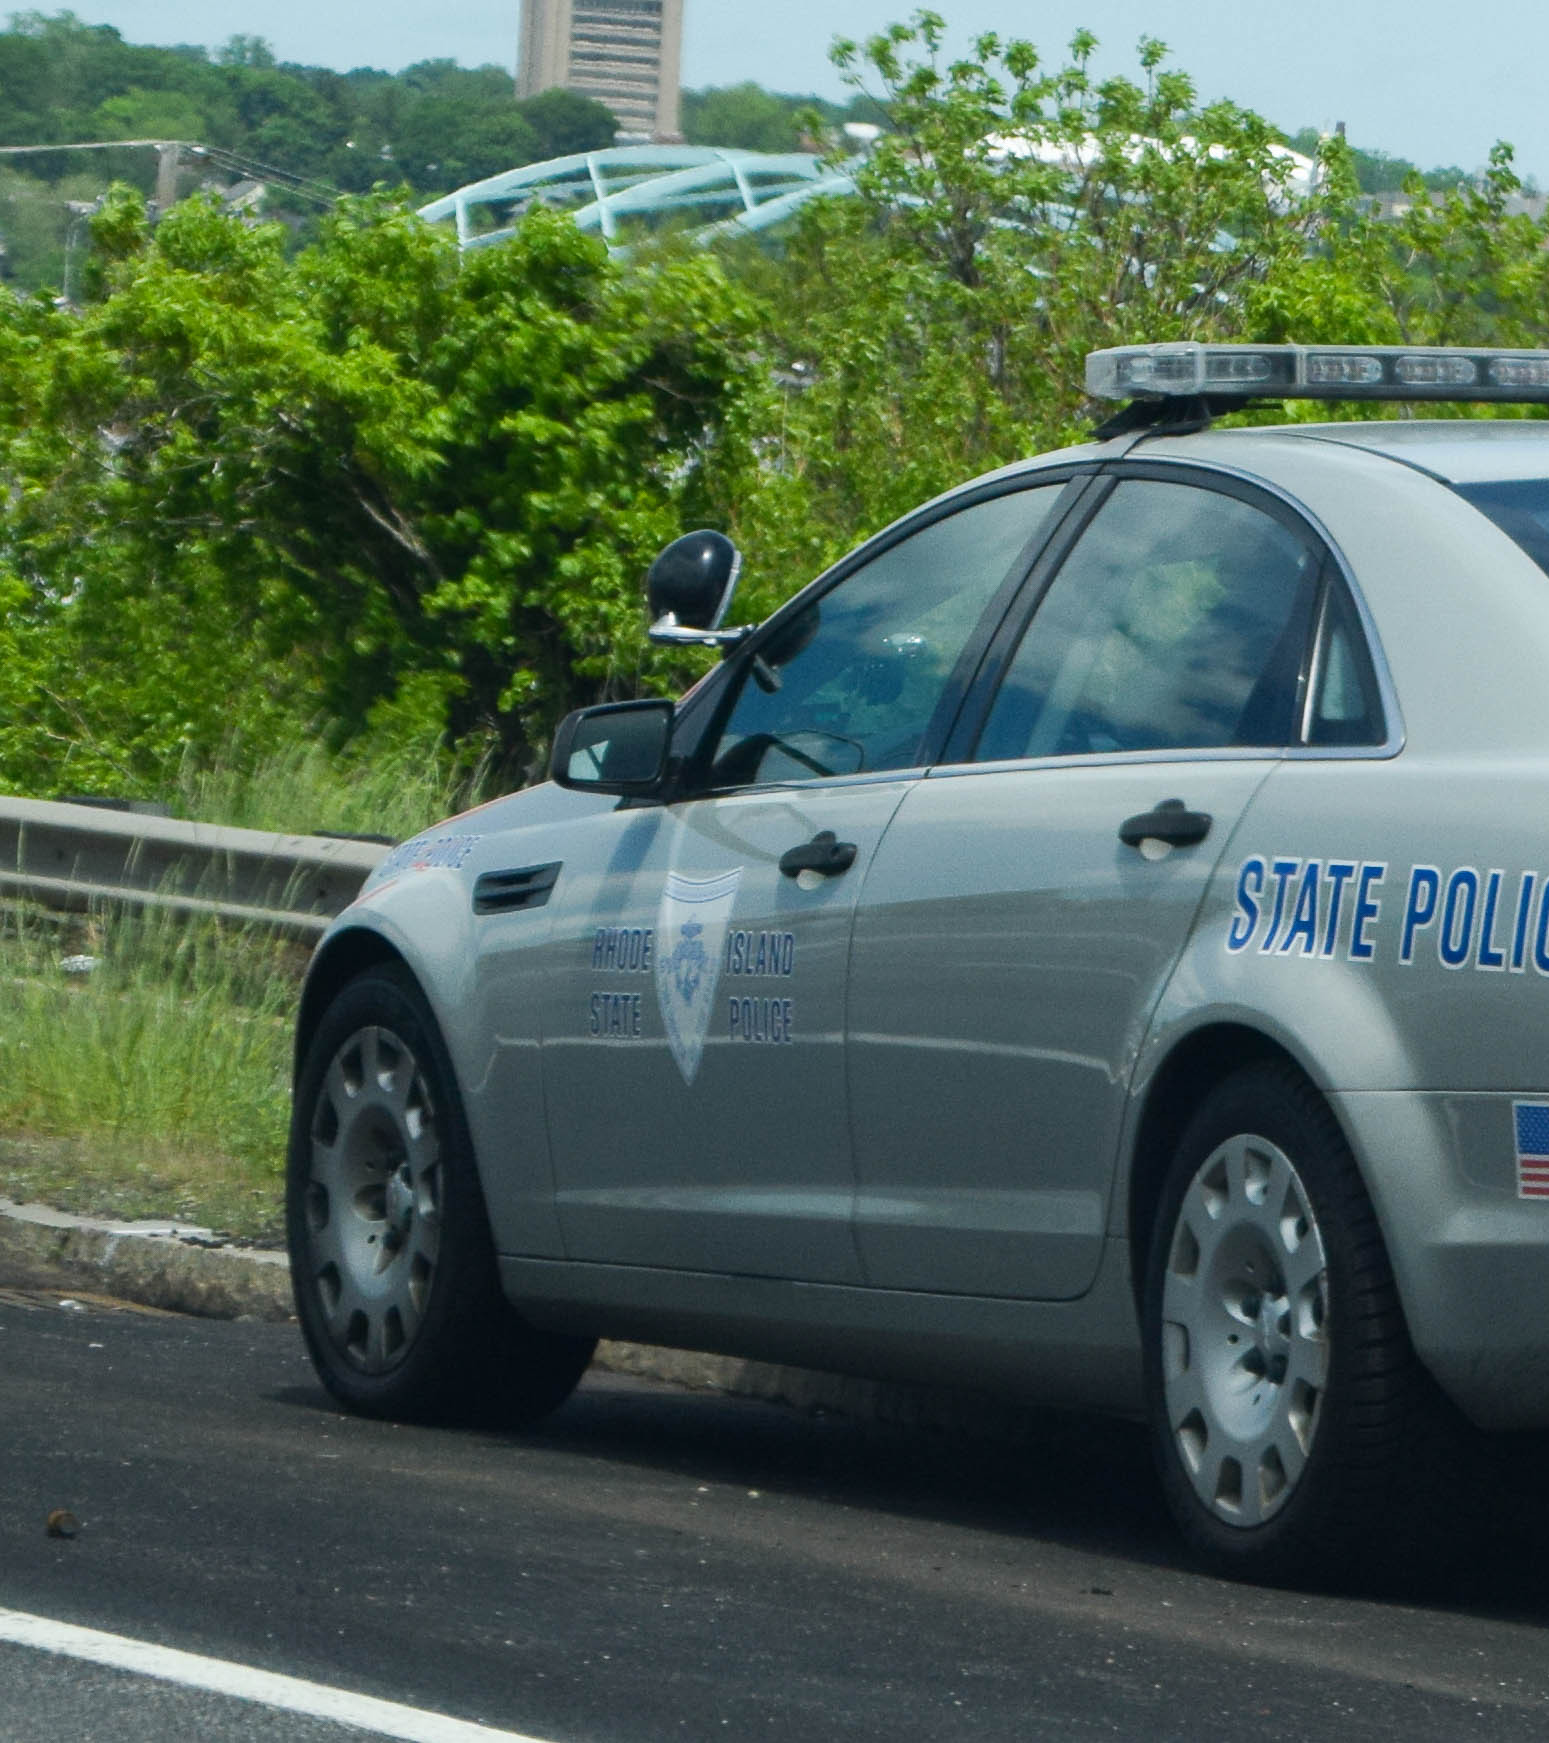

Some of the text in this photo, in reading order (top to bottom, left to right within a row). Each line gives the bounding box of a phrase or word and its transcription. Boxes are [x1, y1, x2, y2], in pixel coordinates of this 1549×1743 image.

[1225, 854, 1388, 962] STATE
[592, 926, 794, 977] RHODE ISLAND
[590, 992, 793, 1045] STATE POLICE
